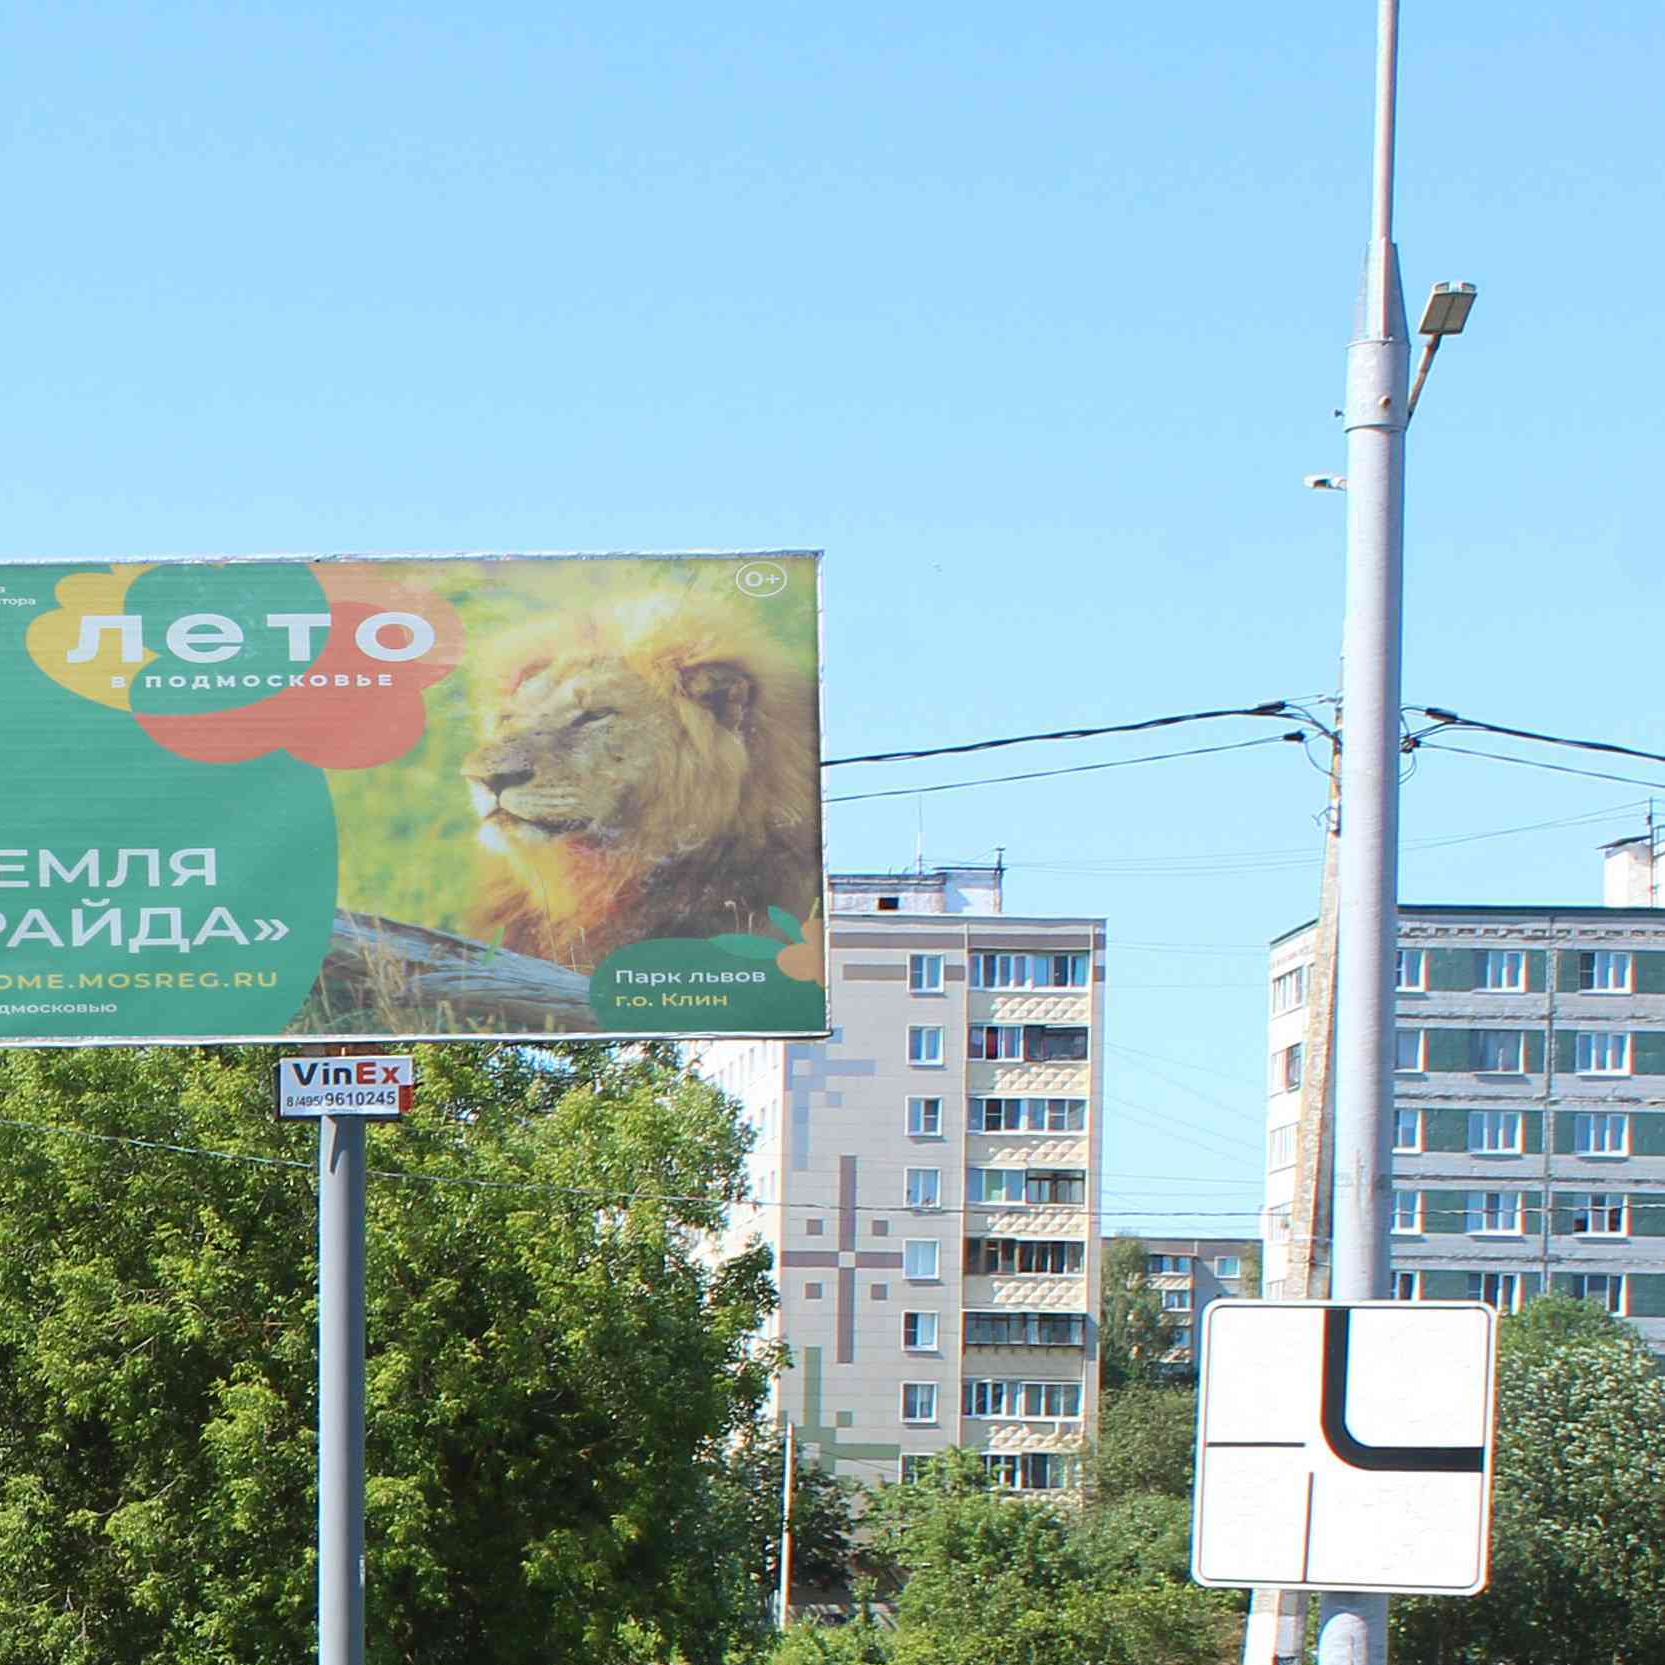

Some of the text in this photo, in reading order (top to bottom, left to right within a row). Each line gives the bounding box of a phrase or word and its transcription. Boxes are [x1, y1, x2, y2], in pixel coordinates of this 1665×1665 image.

[615, 970, 767, 986] Парк львов
[615, 993, 728, 1007] г.о. Клин
[292, 1062, 400, 1086] VinEx
